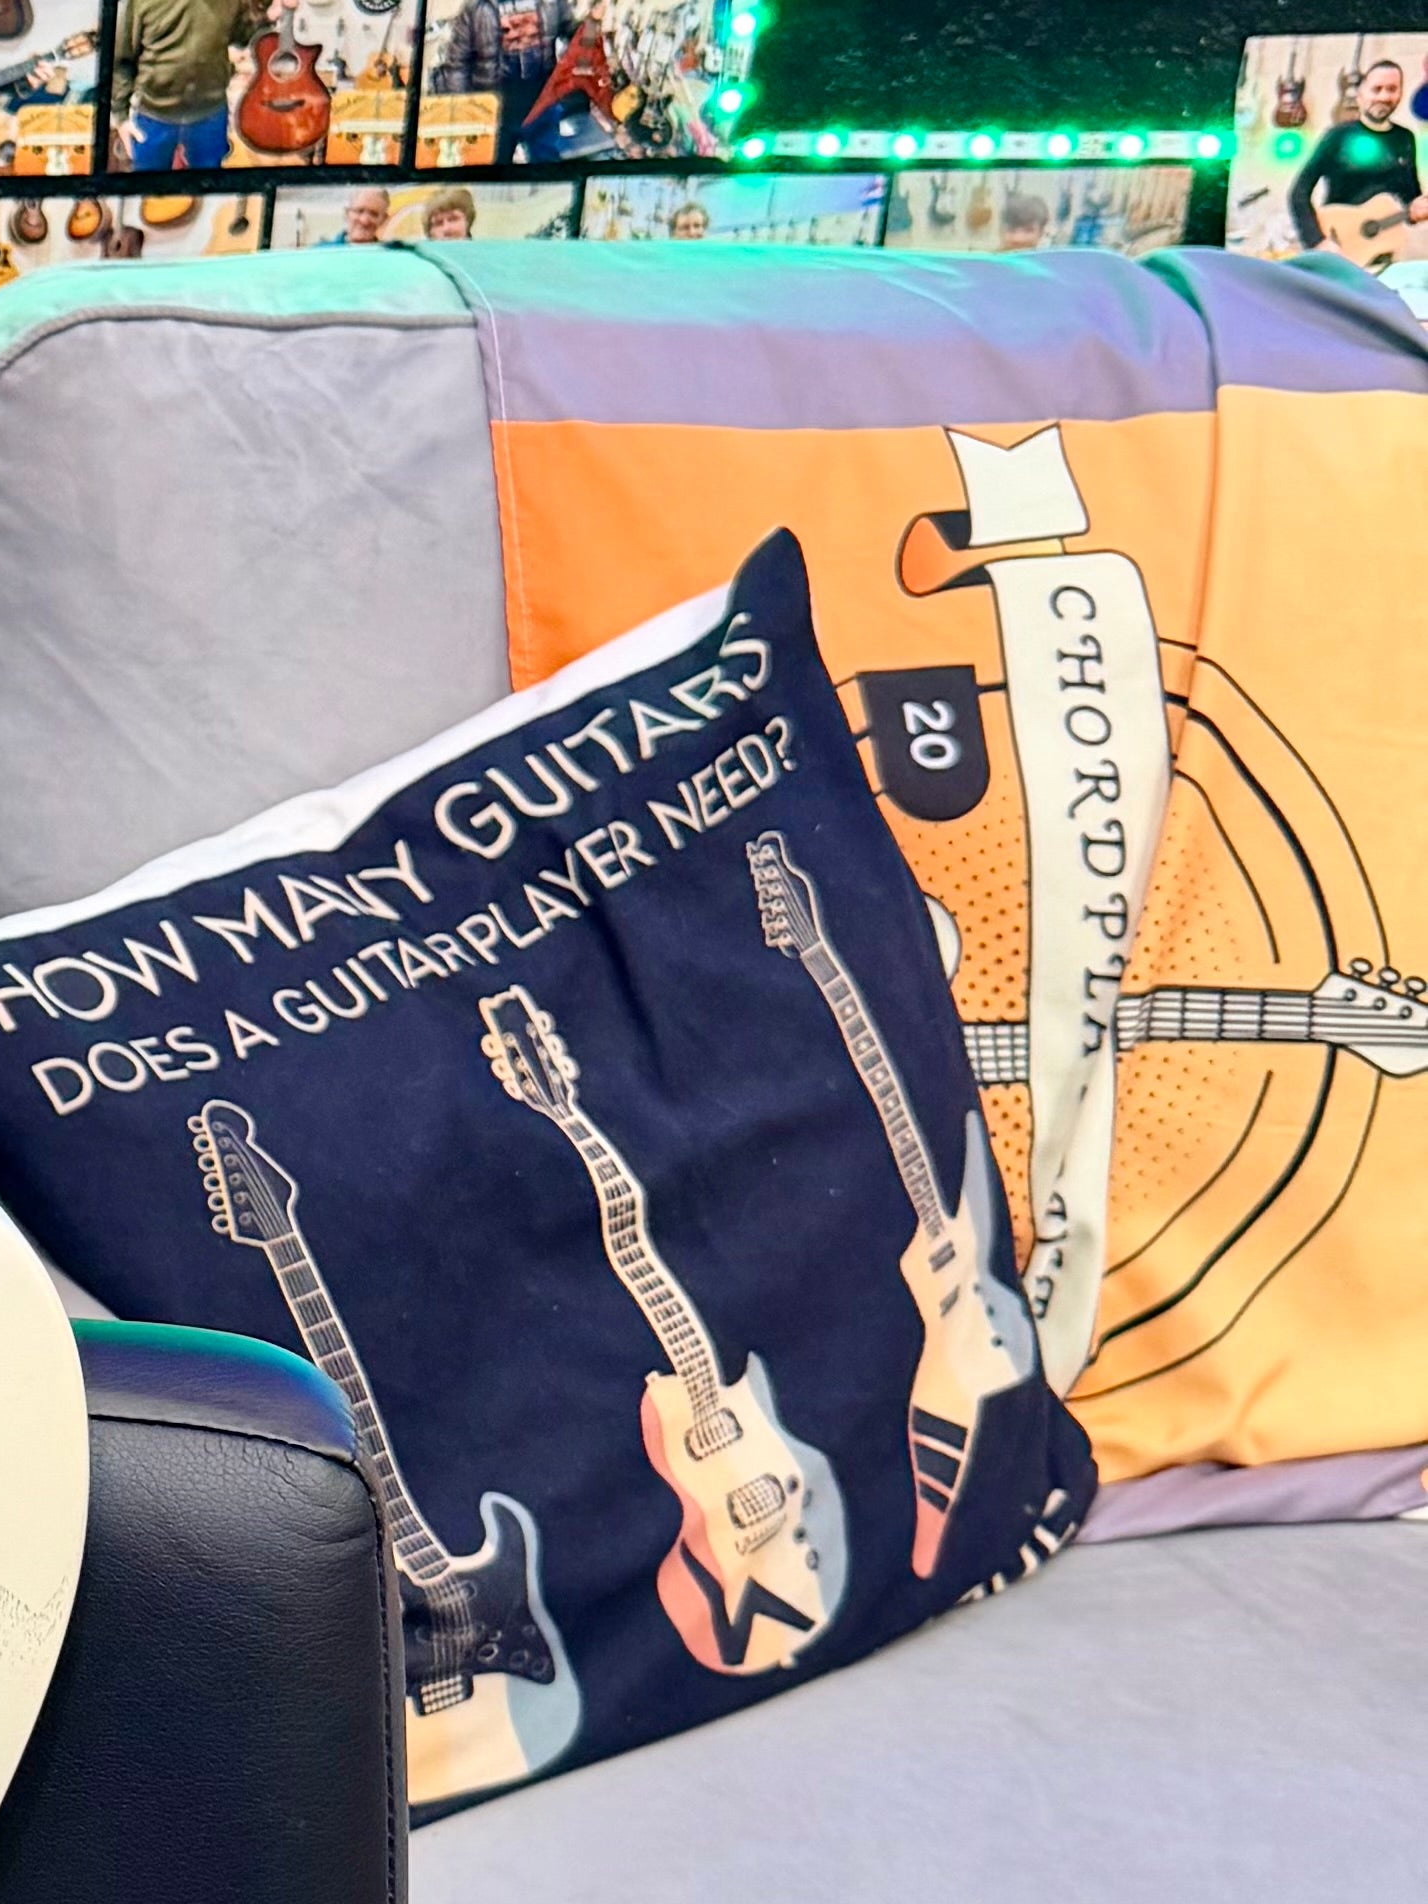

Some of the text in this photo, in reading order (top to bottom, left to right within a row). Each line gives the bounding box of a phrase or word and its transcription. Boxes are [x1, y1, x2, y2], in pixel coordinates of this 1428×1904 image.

[200, 836, 437, 970] MANY
[433, 609, 777, 867] GUITARS
[900, 699, 953, 769] 20
[30, 1024, 221, 1117] DOES
[231, 1003, 280, 1058] A
[647, 715, 797, 859] NEED?
